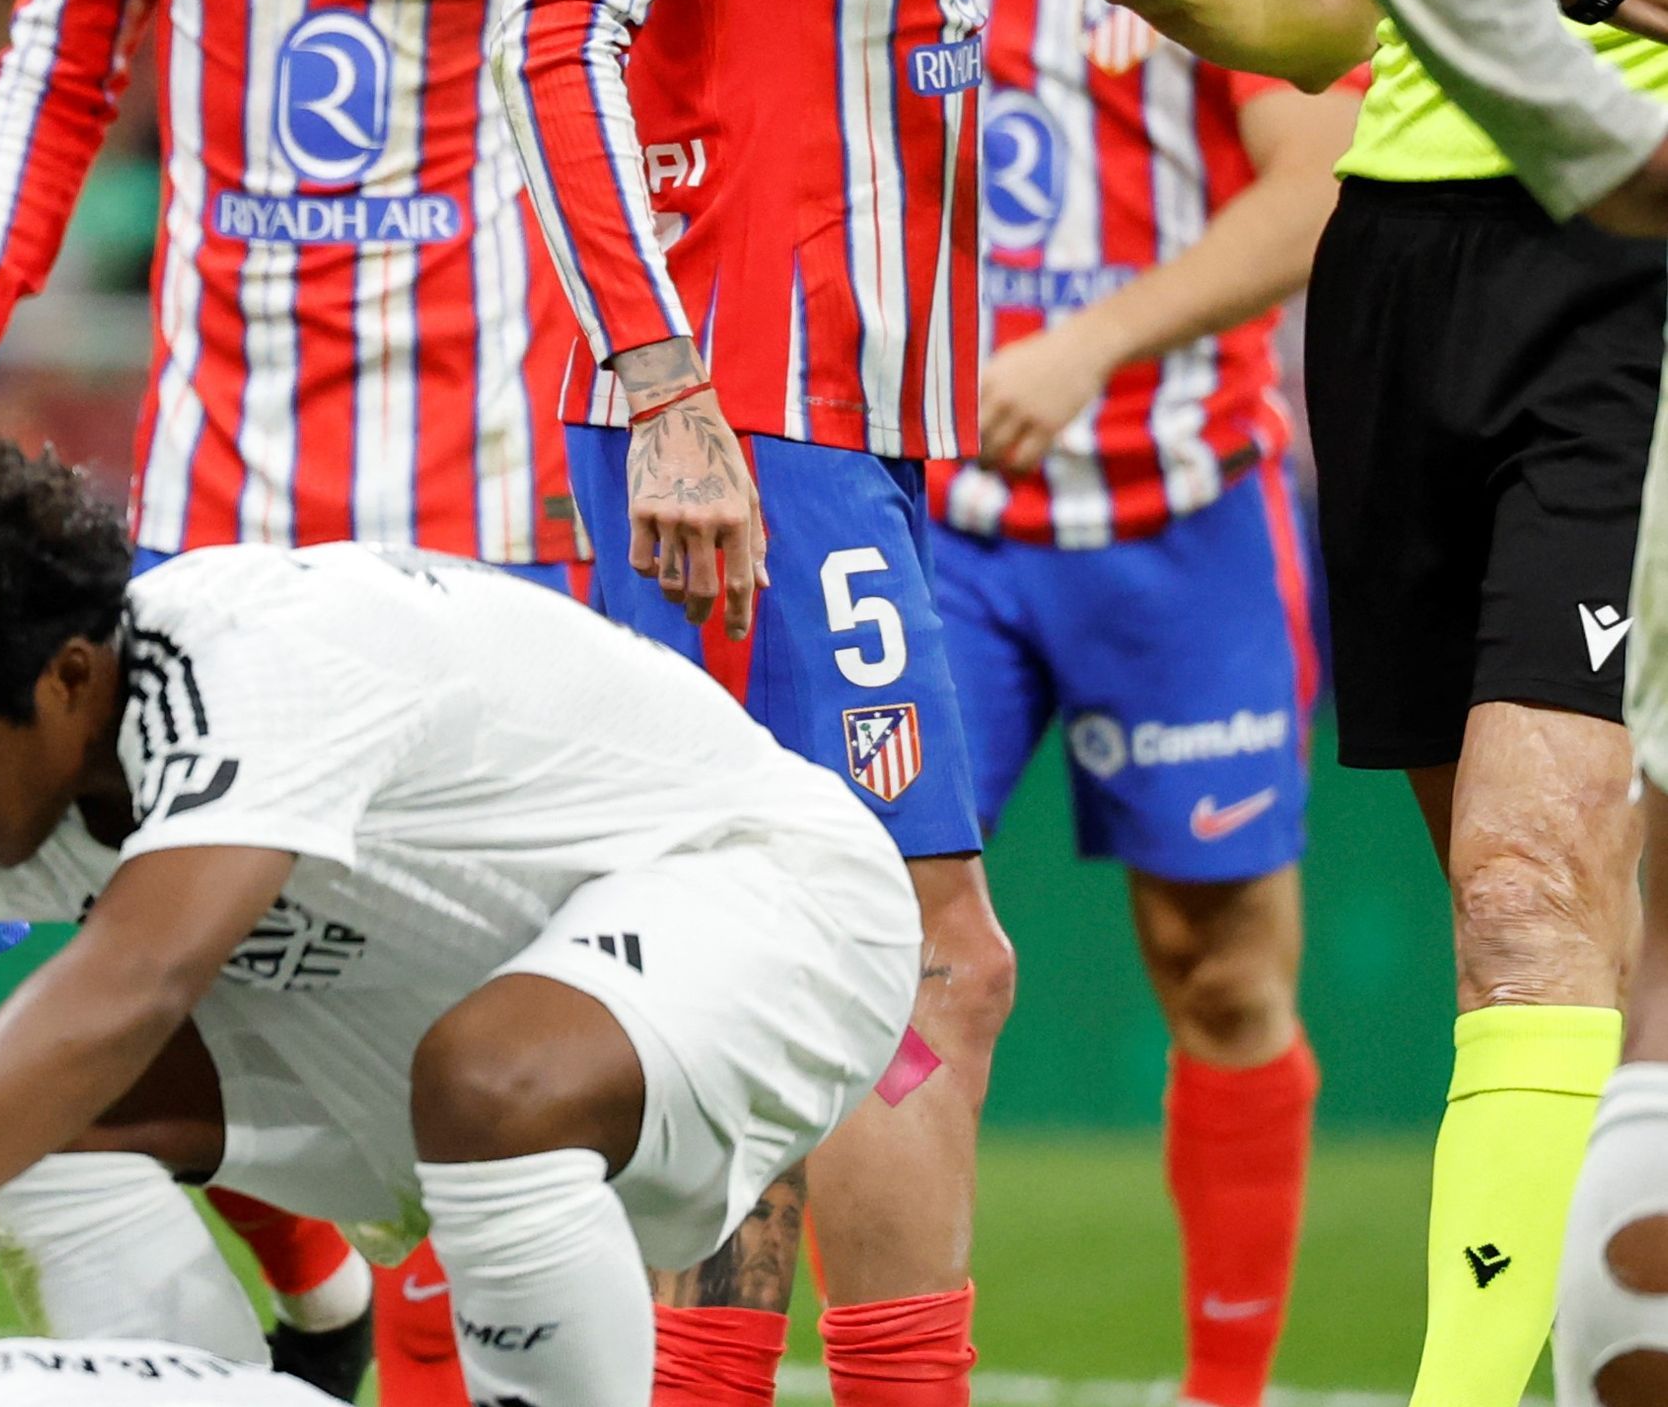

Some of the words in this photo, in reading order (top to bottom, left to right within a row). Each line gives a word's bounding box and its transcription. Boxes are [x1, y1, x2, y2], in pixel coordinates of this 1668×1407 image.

[219, 193, 369, 240] RIYADH
[377, 199, 456, 239] AIR
[820, 546, 907, 688] 5
